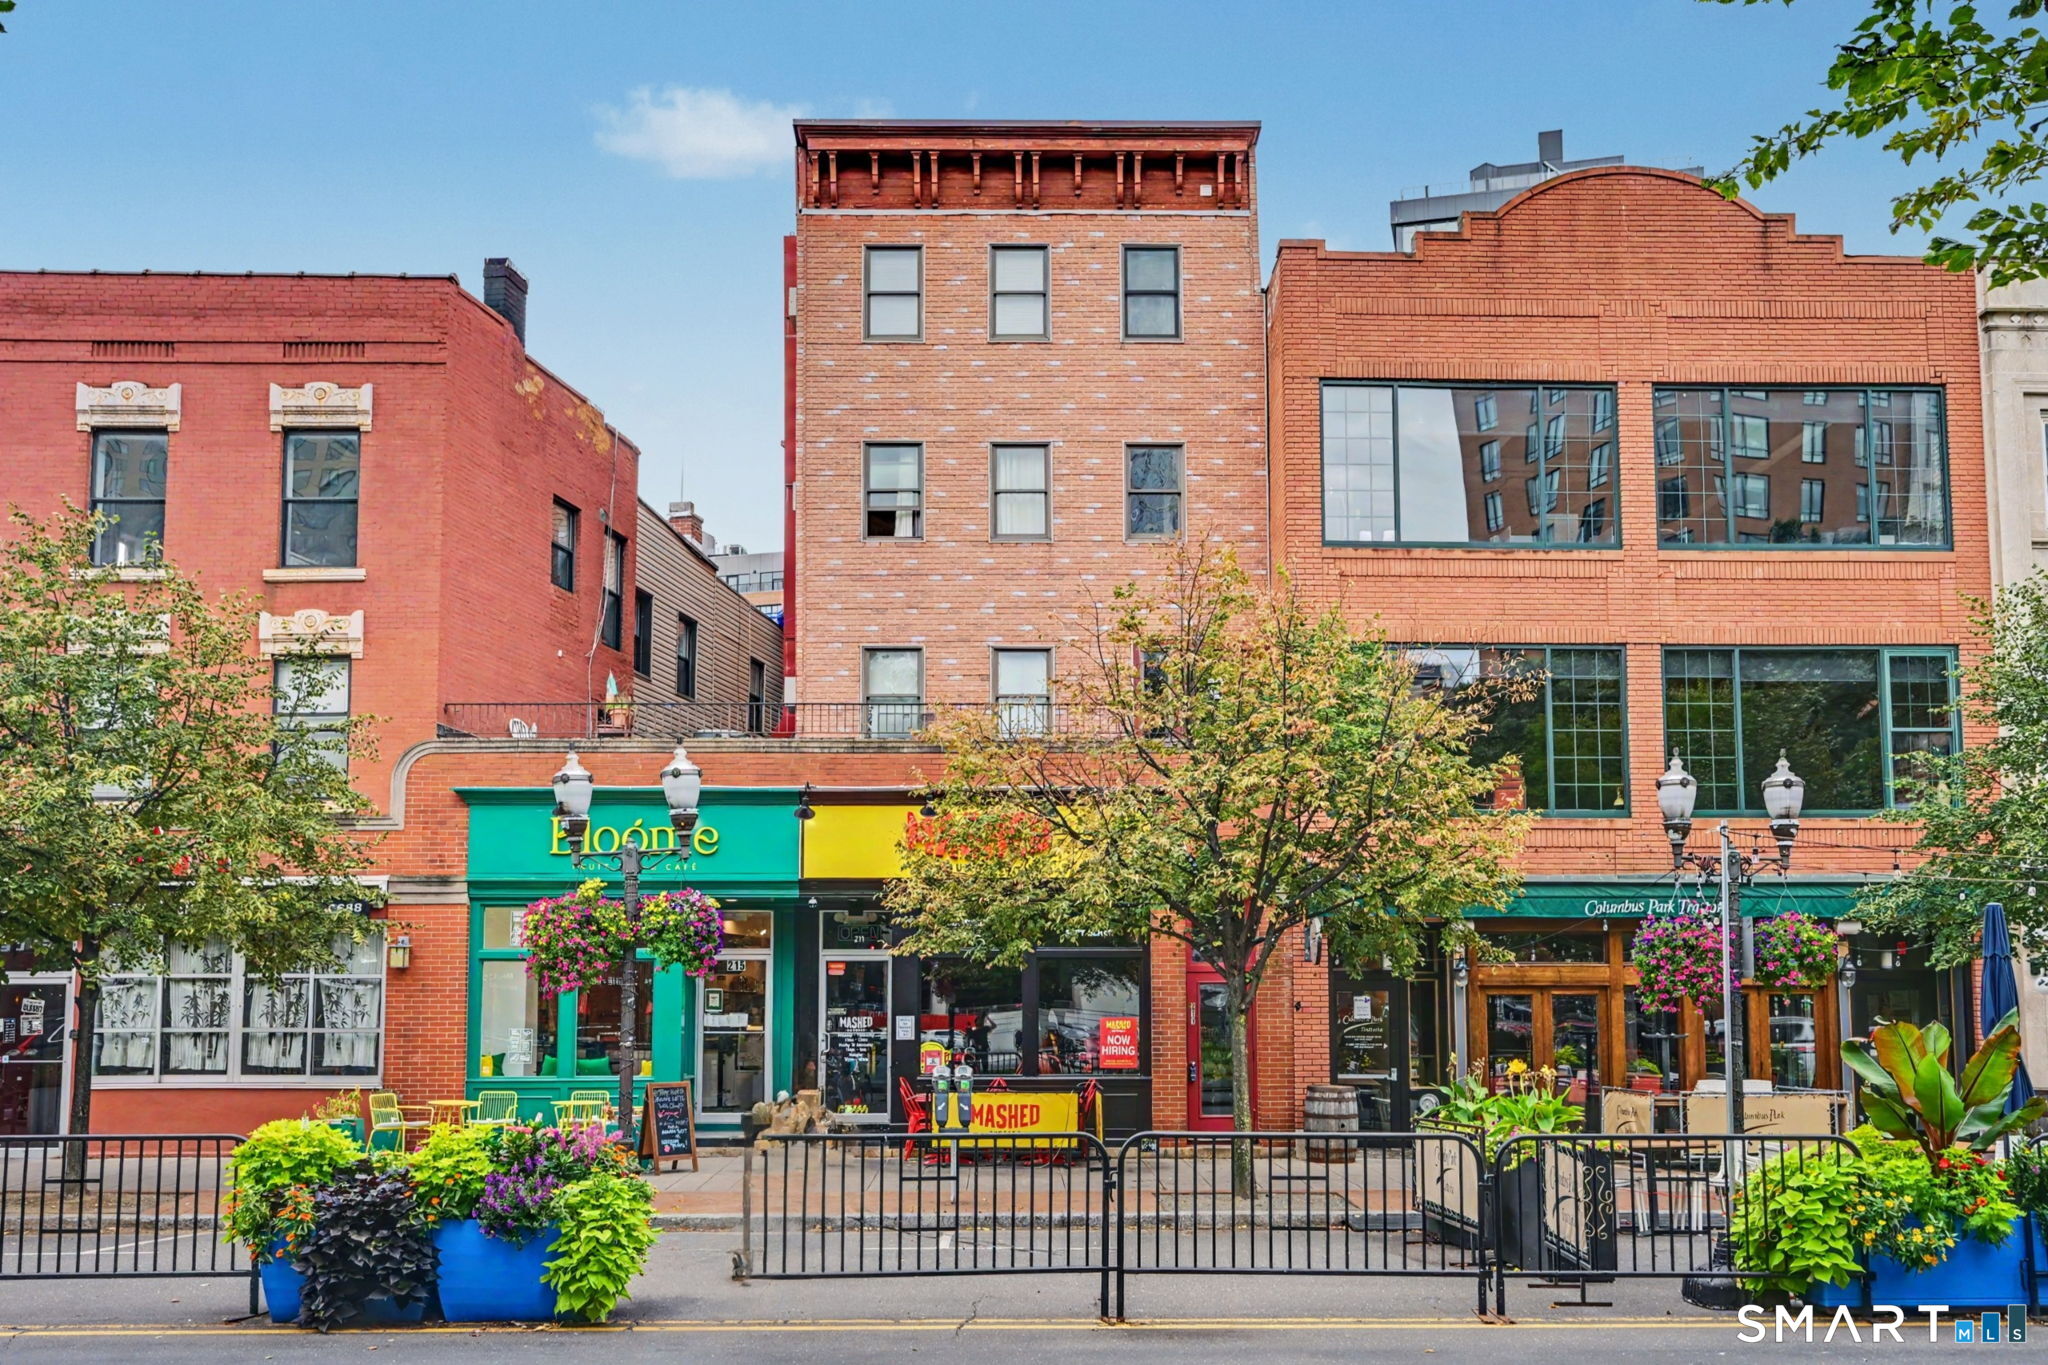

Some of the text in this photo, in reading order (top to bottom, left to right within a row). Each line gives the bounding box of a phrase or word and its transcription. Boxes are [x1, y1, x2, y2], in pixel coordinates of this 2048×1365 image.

[1584, 899, 1645, 917] Columbus
[1647, 898, 1675, 915] Park
[727, 960, 746, 971] 215
[839, 1016, 873, 1029] MASHED
[1107, 1035, 1131, 1045] NOW
[1101, 1046, 1136, 1056] HIRING
[971, 1103, 1040, 1129] MASHED
